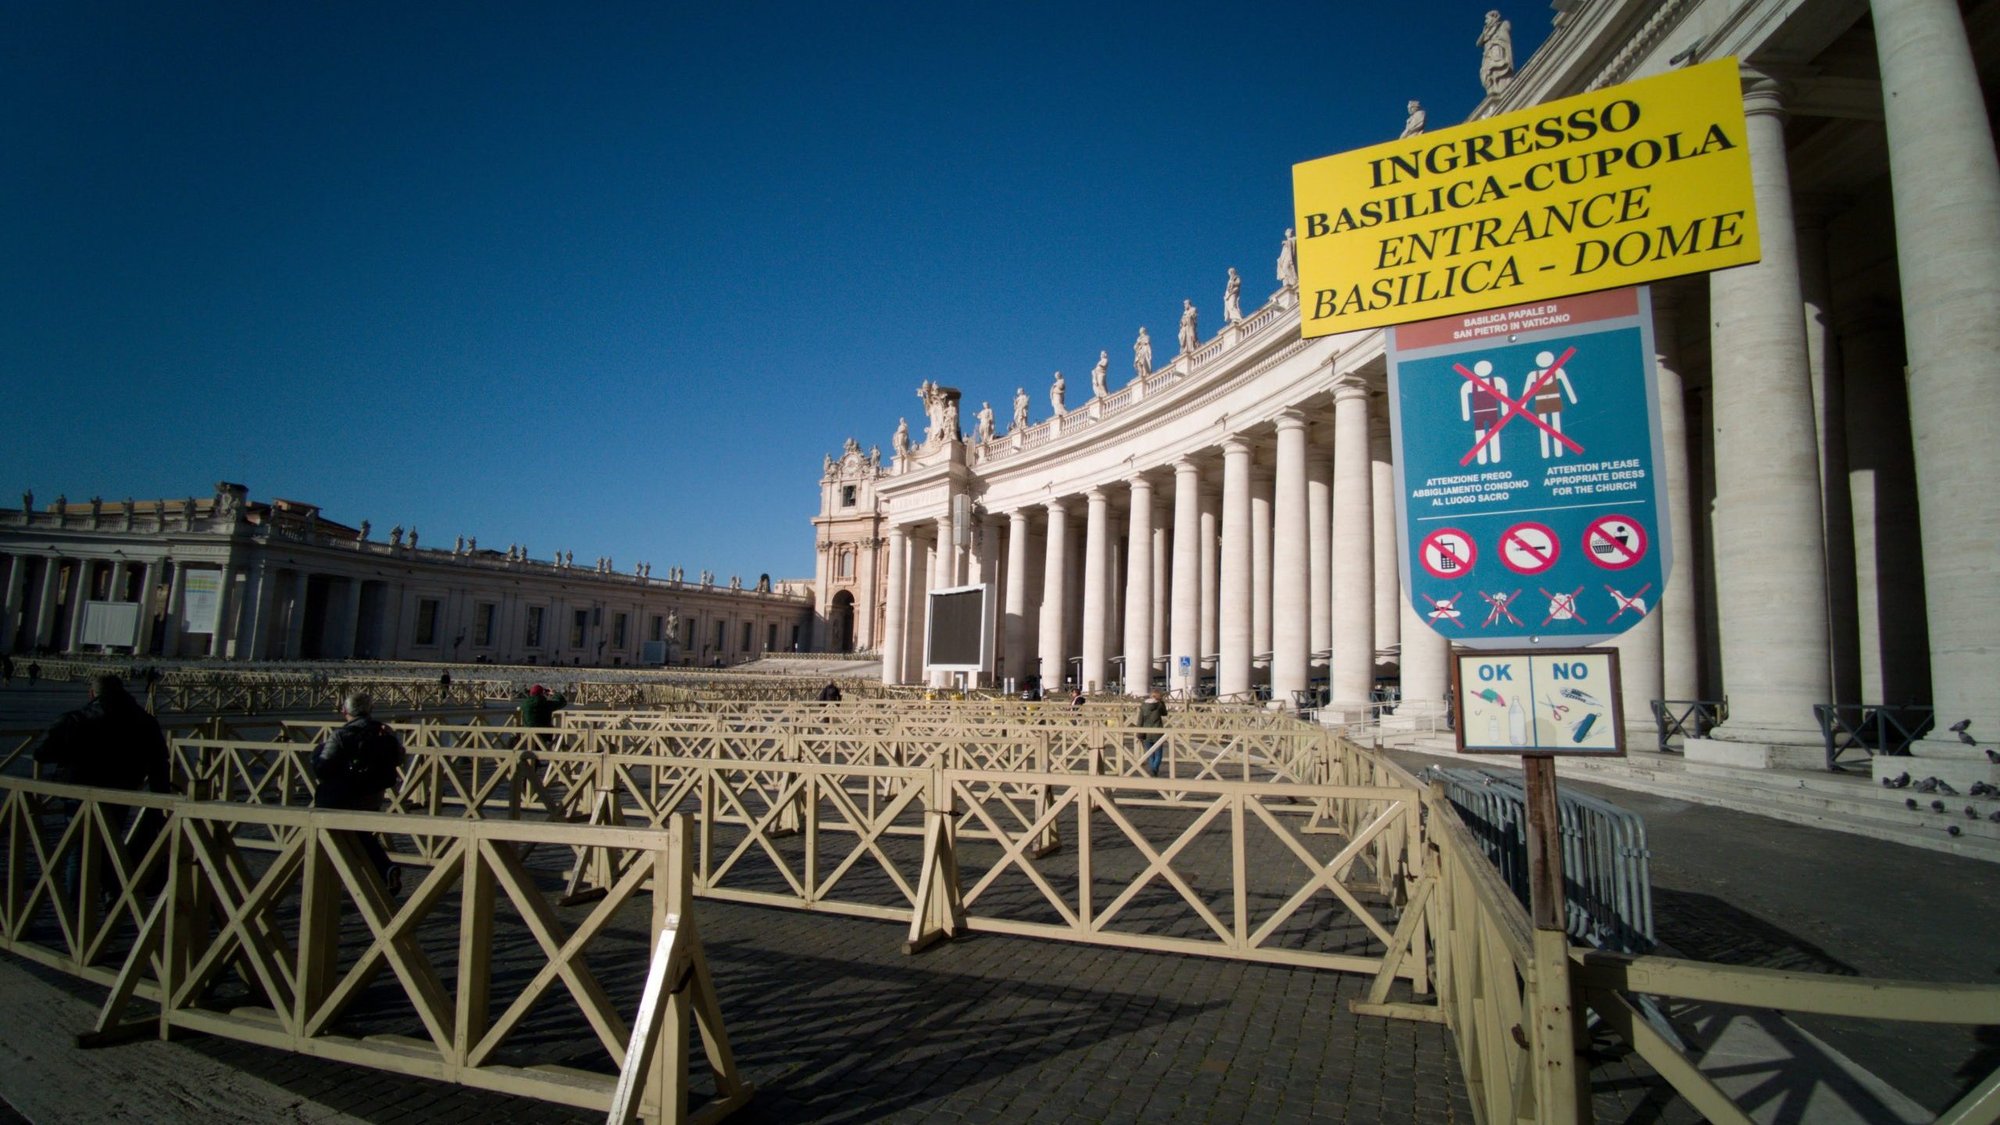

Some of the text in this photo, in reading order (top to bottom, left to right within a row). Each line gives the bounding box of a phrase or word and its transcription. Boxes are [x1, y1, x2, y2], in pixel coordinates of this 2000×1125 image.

[1368, 99, 1641, 189] INGRESSO
[1304, 123, 1737, 239] BASILICA-CUPOLA
[1373, 184, 1652, 271] ENTRANCE
[1310, 256, 1525, 321] BASILICA
[1570, 210, 1745, 276] DOME
[1463, 304, 1557, 327] BASILICA PAPALE DI
[1453, 313, 1571, 339] SAN PIETRO IN VATICANO
[1546, 458, 1640, 475] ATTENTION PLEASE
[1426, 471, 1513, 486] ATTENZIONE PREGO
[1543, 469, 1645, 486] APPROPRIATE DRESS
[1412, 480, 1529, 498] ABBIGLIAMENTO CONSONO
[1552, 481, 1637, 496] FOR THE CHURCH
[1432, 492, 1510, 506] AL LUOGO SACRO
[1478, 664, 1513, 682] OK
[1552, 662, 1589, 681] NO
